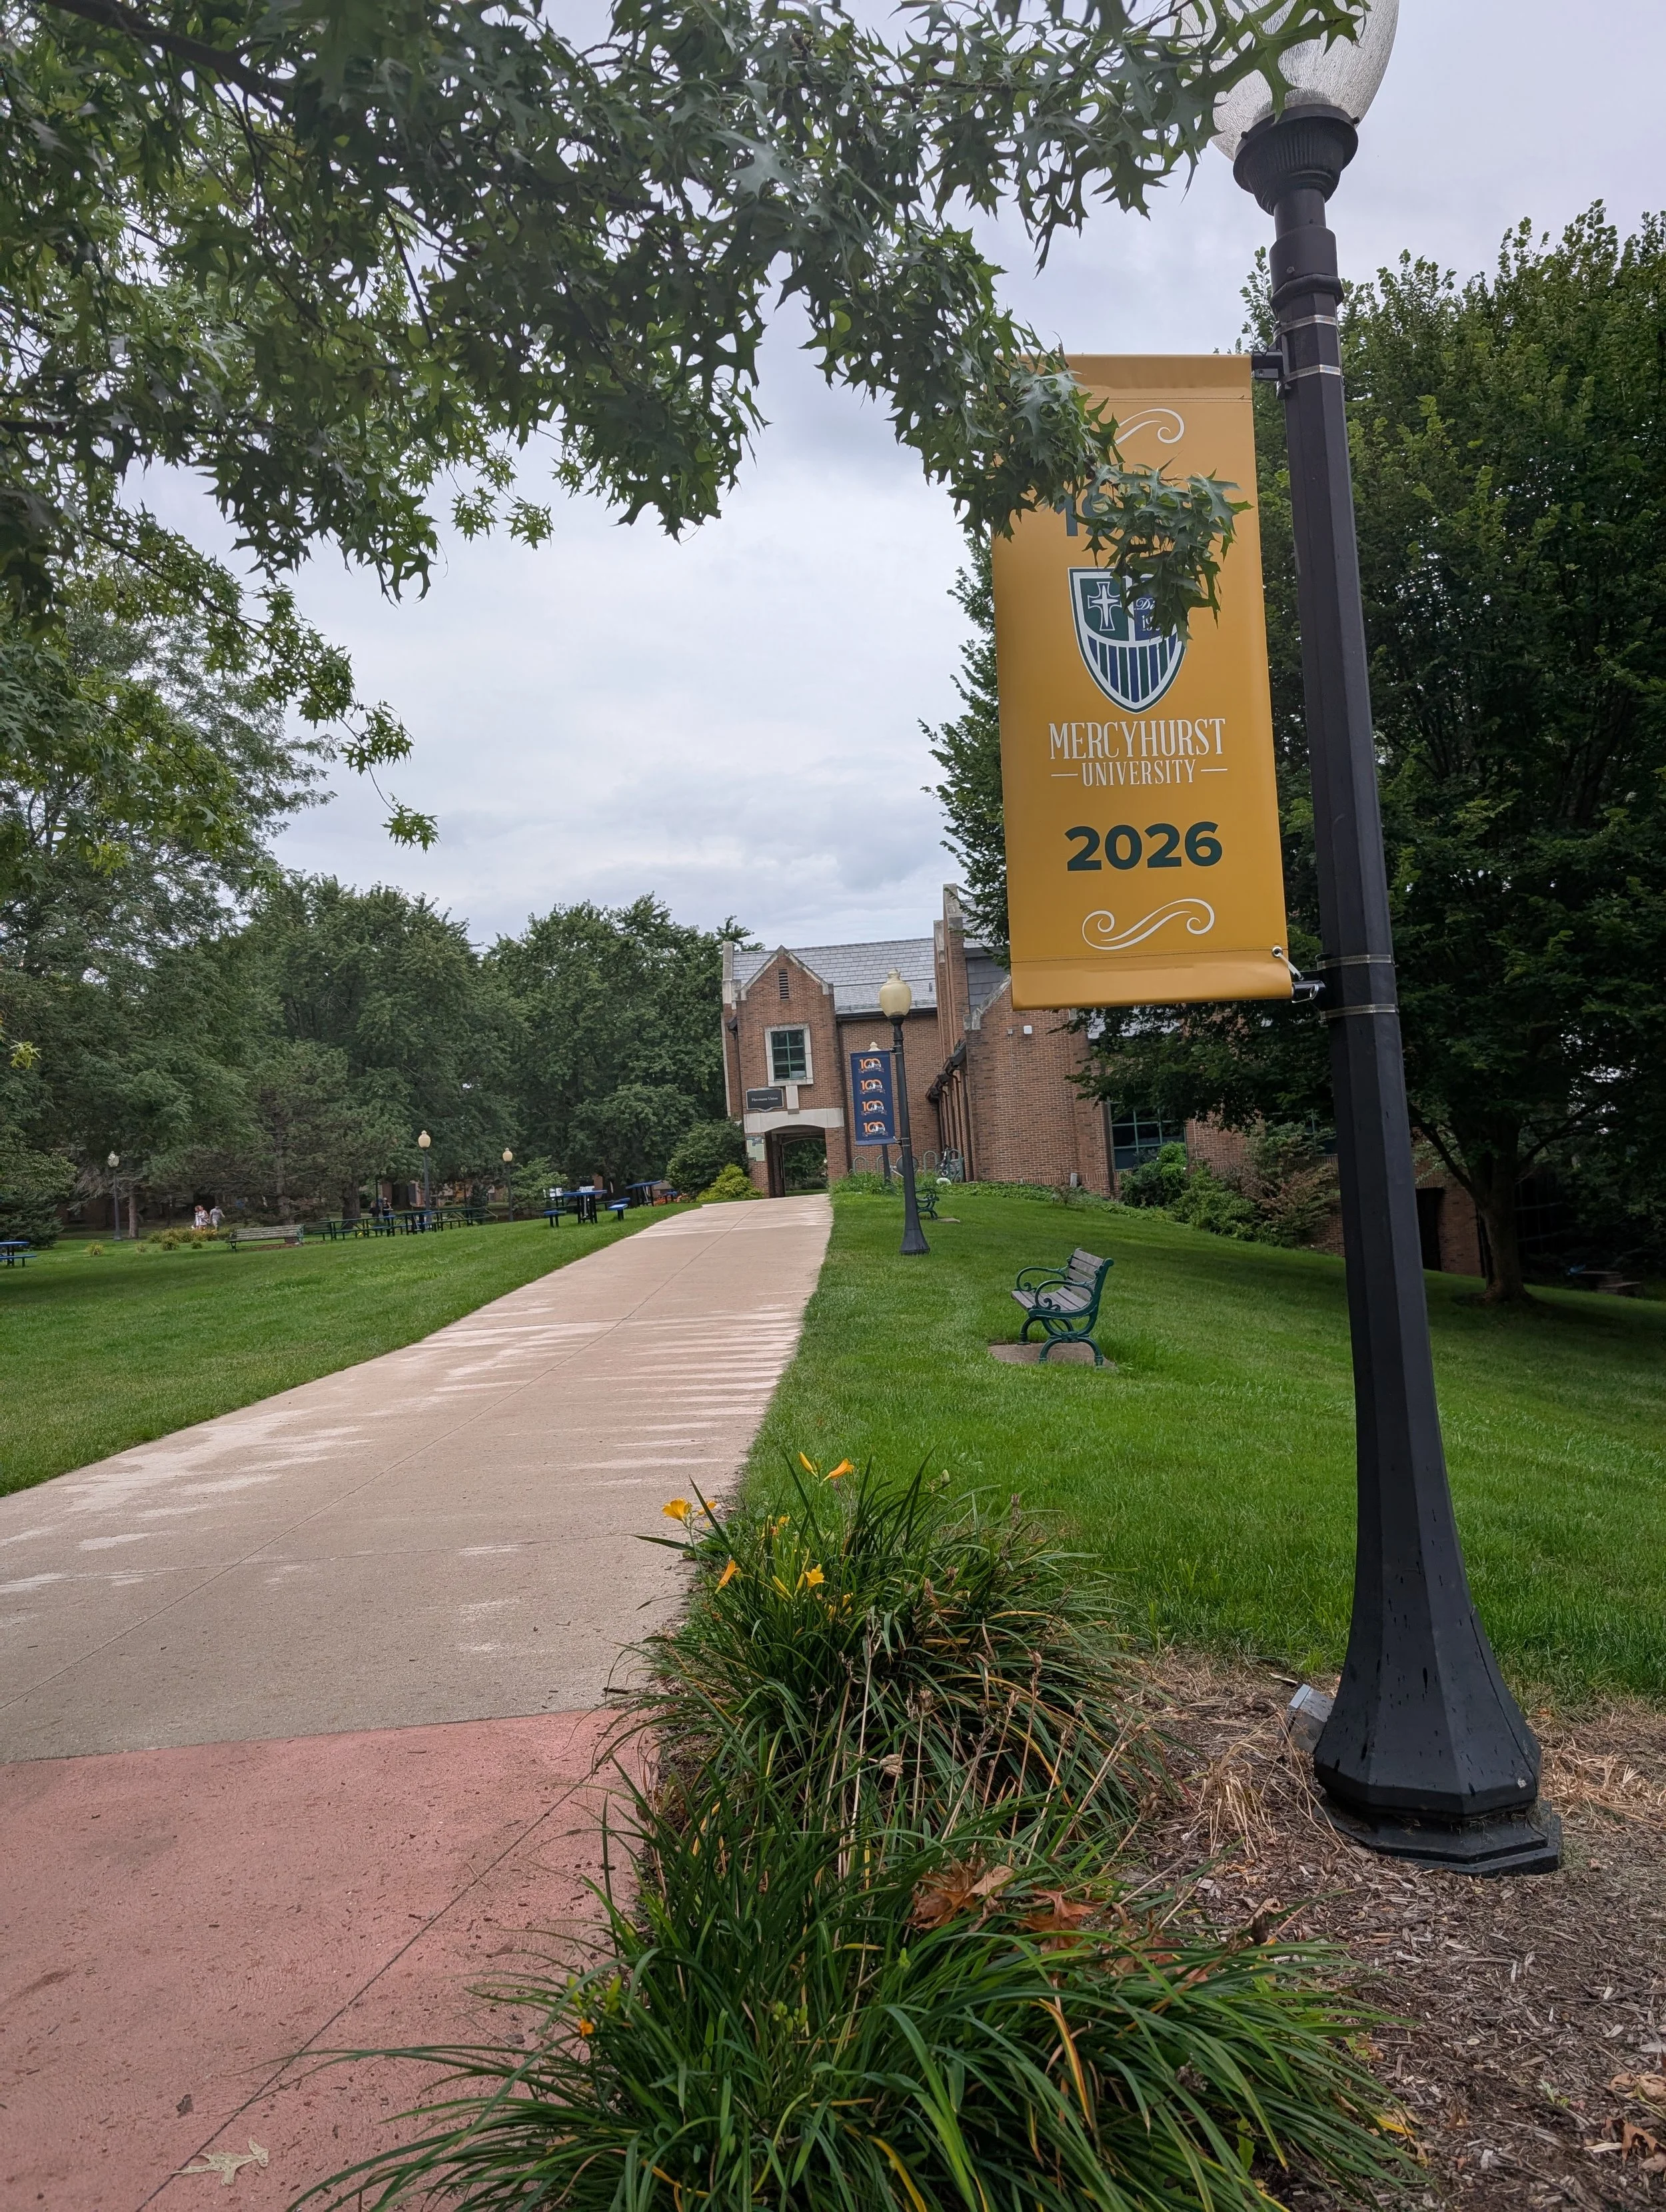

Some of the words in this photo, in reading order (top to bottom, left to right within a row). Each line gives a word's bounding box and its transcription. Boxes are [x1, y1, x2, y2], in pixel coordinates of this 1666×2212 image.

[1049, 718, 1226, 760] MERCYHURST
[1082, 759, 1196, 787] UNIVERSITY
[1064, 821, 1223, 871] 2026
[860, 1058, 882, 1069] 100
[860, 1079, 882, 1091] 100
[862, 1100, 884, 1111] 100
[863, 1121, 885, 1133] 100
